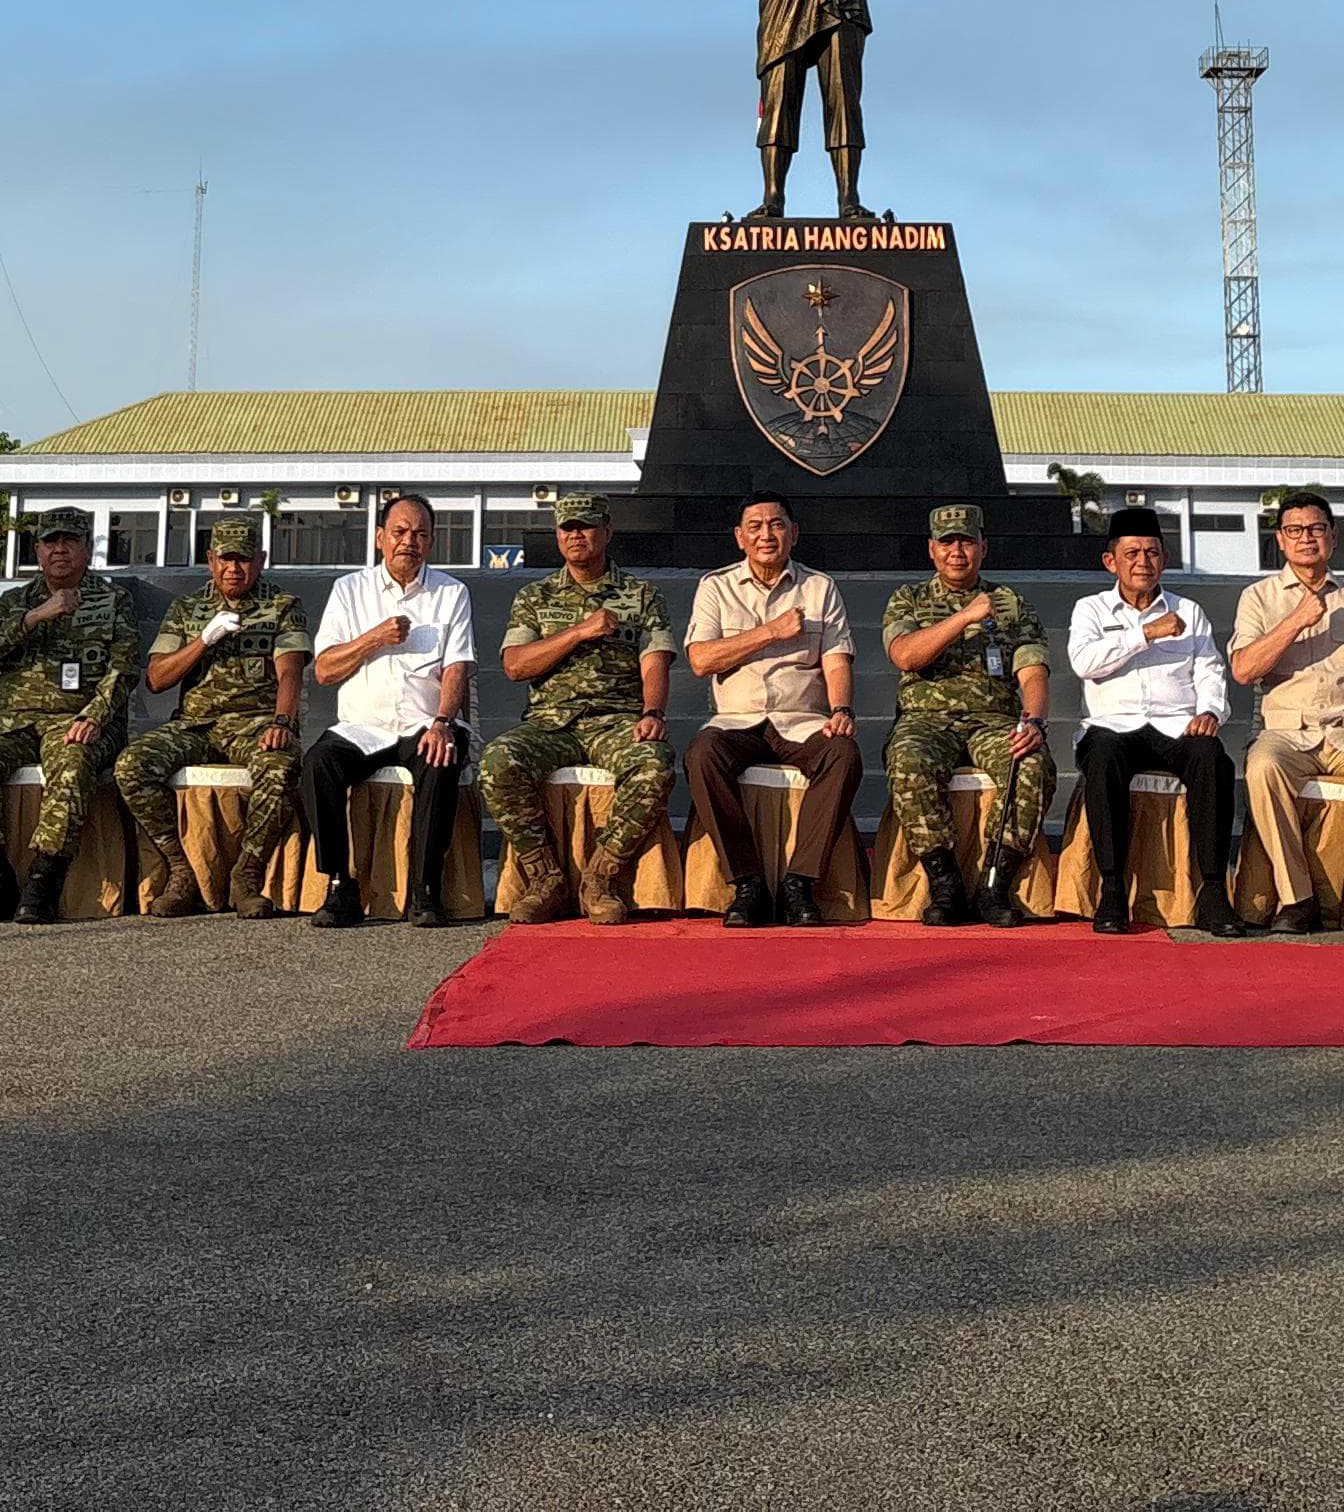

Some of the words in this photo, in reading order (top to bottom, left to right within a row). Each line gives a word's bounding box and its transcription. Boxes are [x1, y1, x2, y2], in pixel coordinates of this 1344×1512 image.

[703, 226, 800, 251] KSATRIA
[803, 226, 868, 251] HANG
[871, 225, 946, 250] NADIM
[77, 614, 94, 624] TNI
[96, 612, 111, 621] AU
[538, 610, 575, 621] TANDYO
[260, 621, 276, 631] AD
